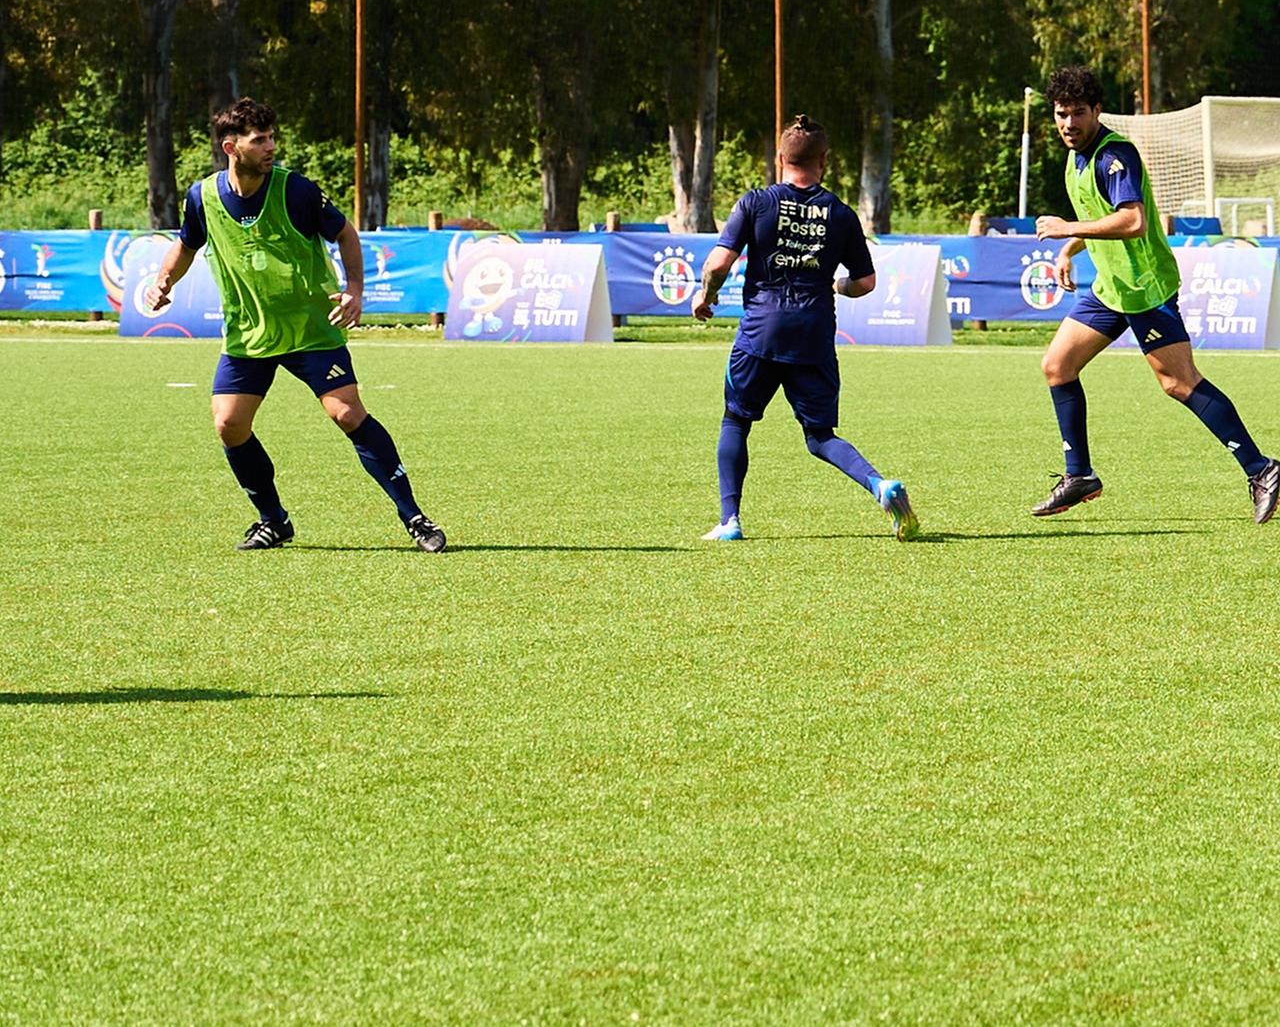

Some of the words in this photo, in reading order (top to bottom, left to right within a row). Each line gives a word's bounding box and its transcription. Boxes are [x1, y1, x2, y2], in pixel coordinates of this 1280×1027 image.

[798, 203, 828, 220] TIM
[778, 215, 826, 236] Poste
[774, 254, 800, 267] eni
[533, 310, 578, 326] TUTTI
[1206, 316, 1256, 334] TUTTI
